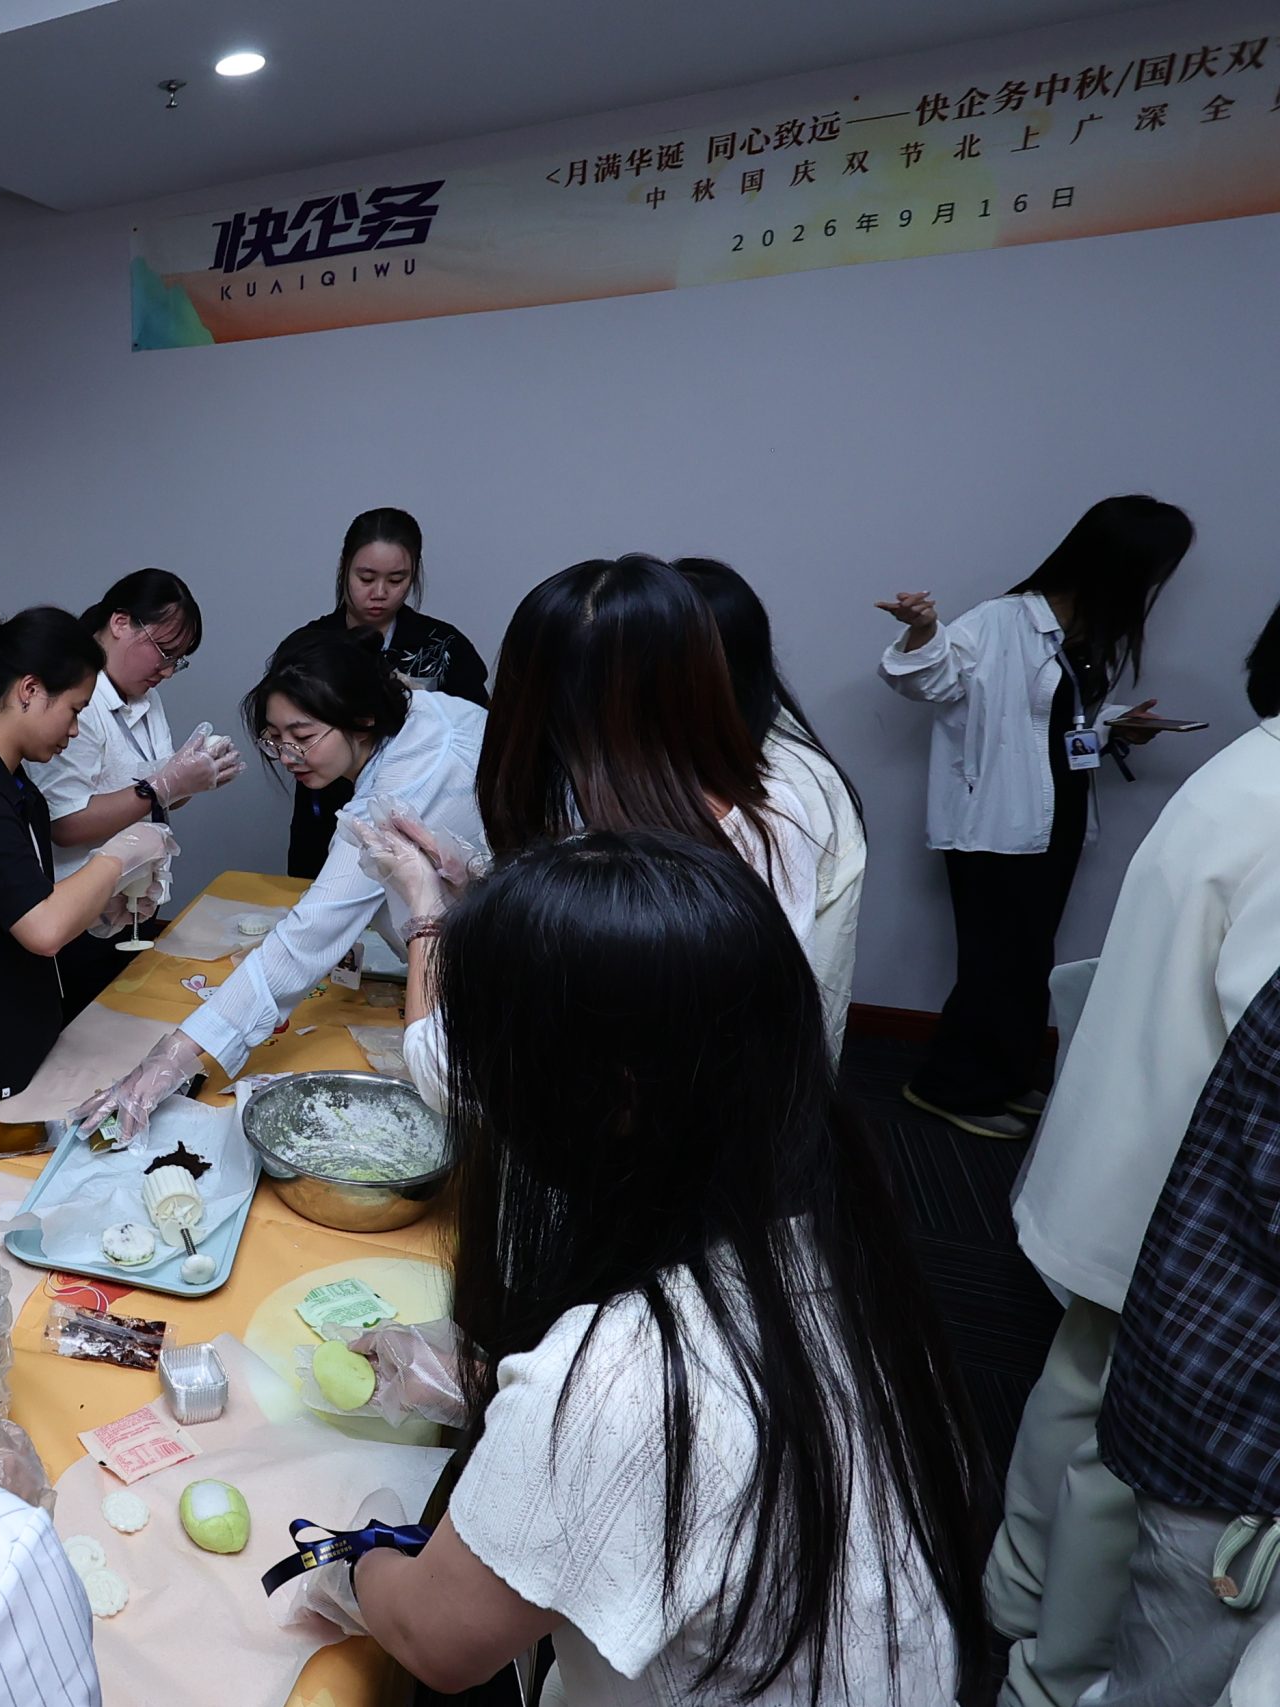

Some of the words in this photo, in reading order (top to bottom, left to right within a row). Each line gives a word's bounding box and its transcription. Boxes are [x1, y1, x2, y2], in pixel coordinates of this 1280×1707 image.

[706, 36, 1280, 164] 同心致远——快企务中秋/国庆双
[209, 179, 446, 274] 快企务
[731, 186, 1075, 252] 2026年9月16日
[221, 258, 416, 301] KUAIQIWU
